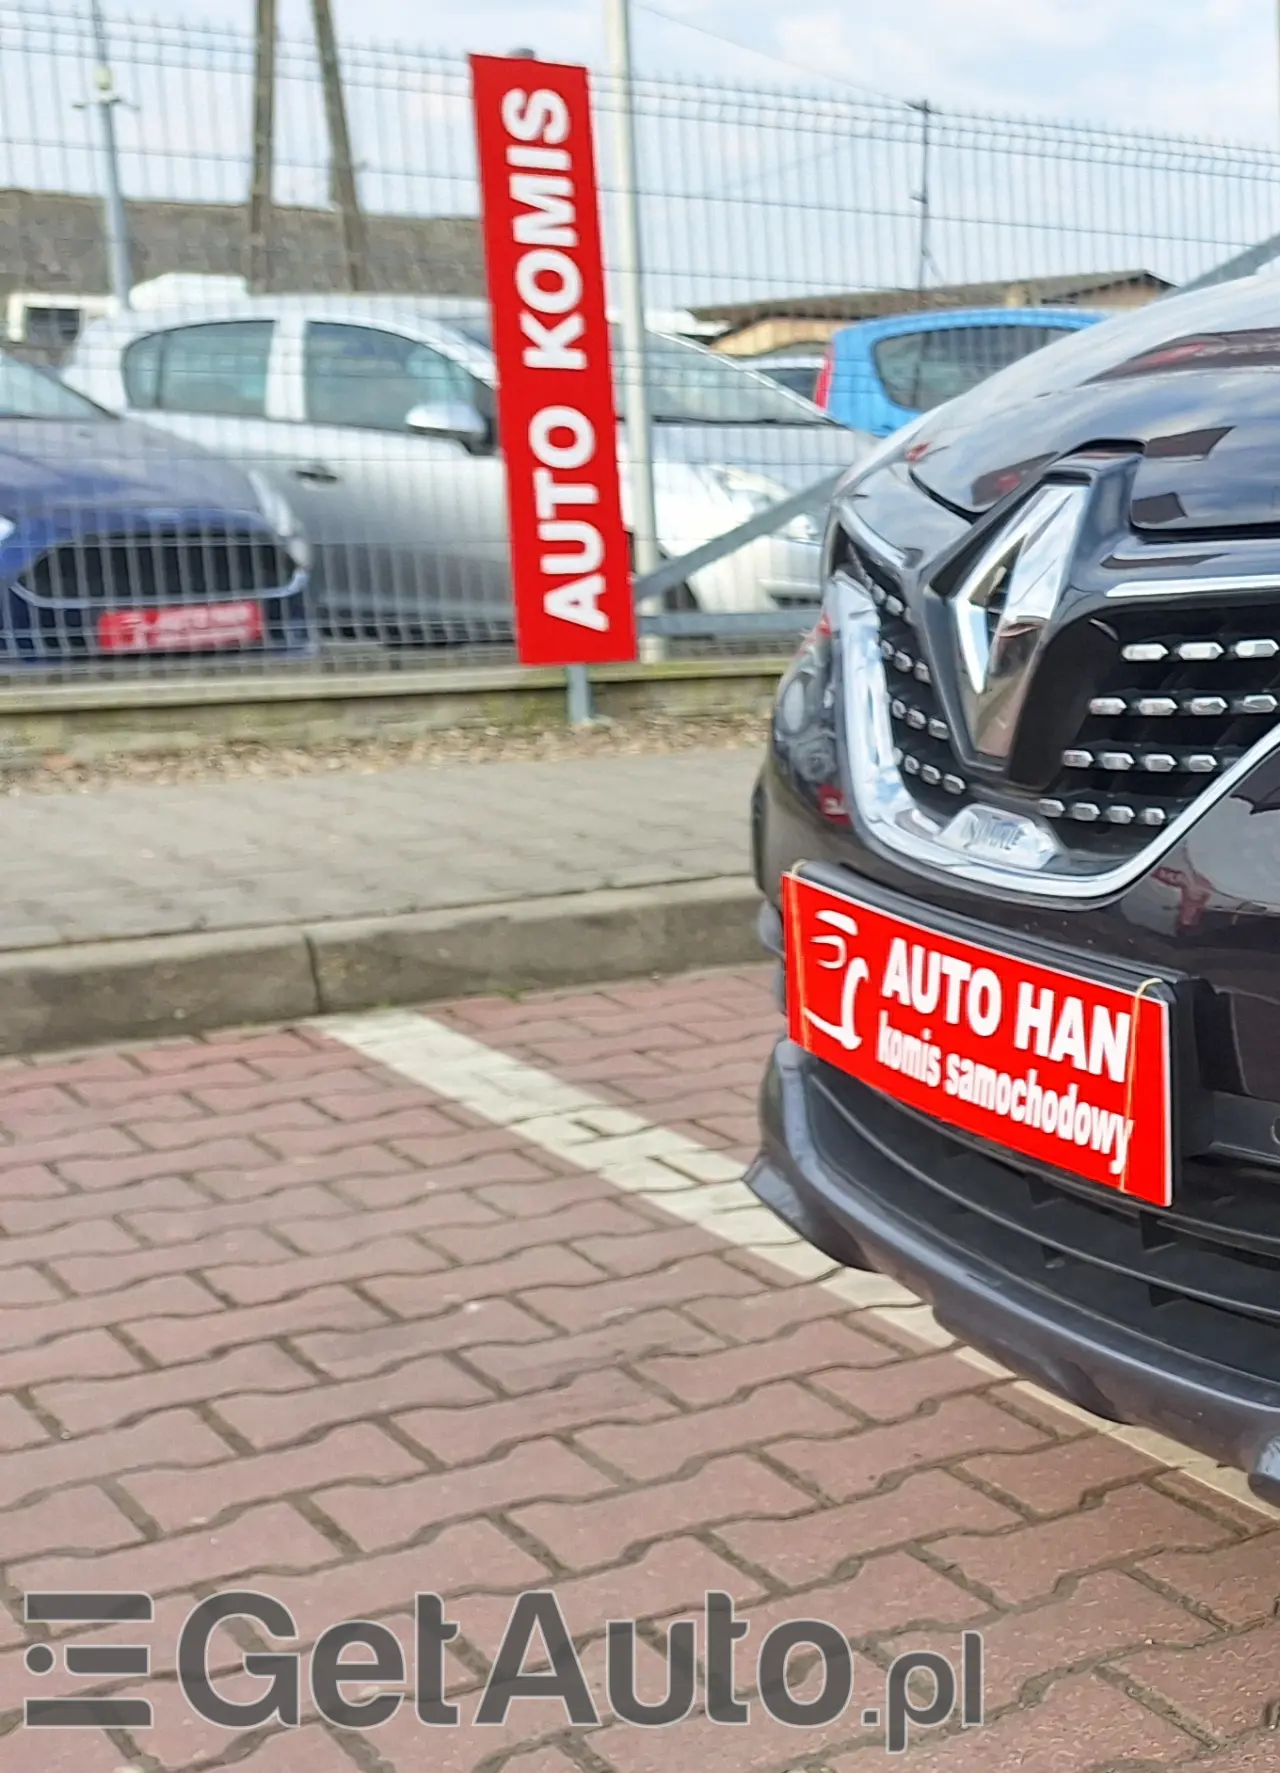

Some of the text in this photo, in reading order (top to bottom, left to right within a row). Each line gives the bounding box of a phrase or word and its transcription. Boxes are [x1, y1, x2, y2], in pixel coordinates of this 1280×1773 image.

[501, 88, 611, 632] AUTO KOMIS
[877, 1010, 1133, 1175] komis samochodowy
[882, 937, 1132, 1083] AUTO HAN
